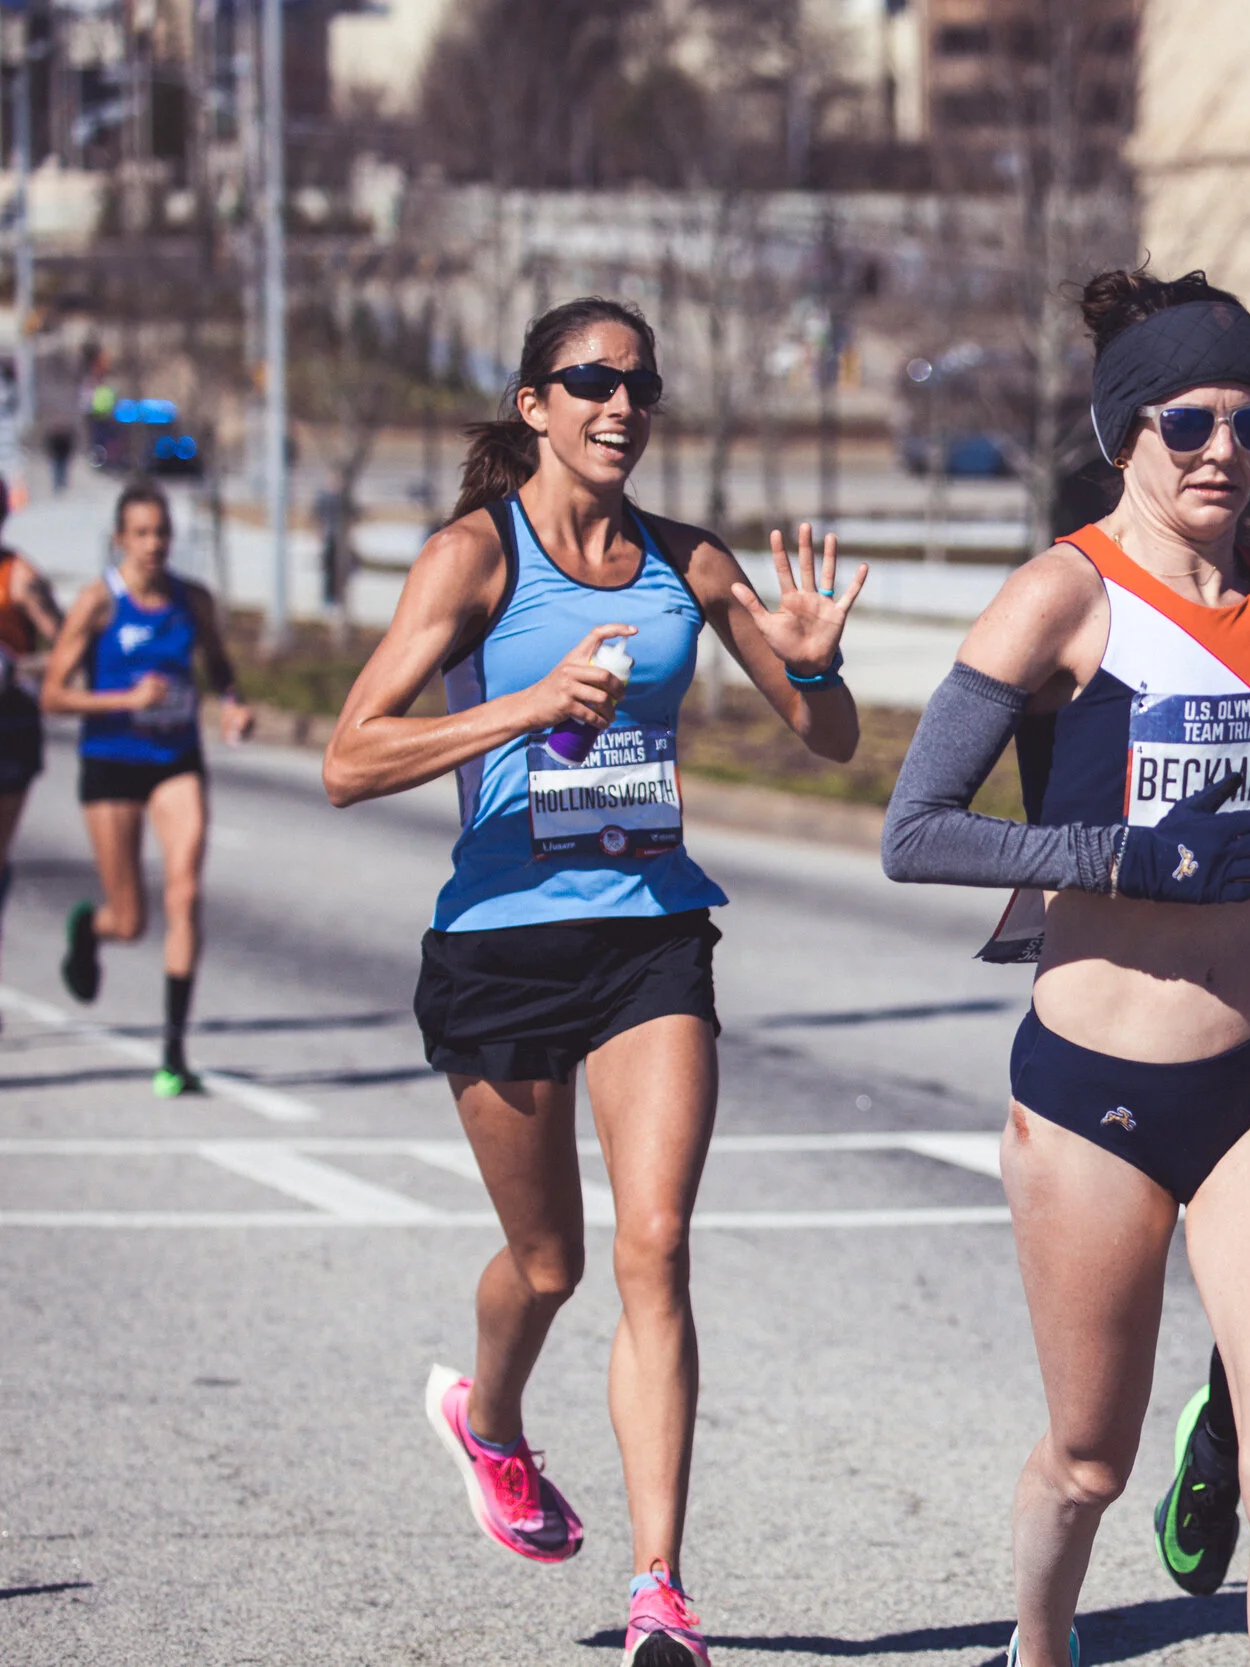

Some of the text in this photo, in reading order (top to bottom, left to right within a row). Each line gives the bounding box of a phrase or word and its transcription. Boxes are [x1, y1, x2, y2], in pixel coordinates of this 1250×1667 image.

[1184, 701, 1214, 720] U.S.
[1183, 722, 1224, 742] TEAM
[603, 747, 645, 766] TRIALS
[534, 779, 675, 813] HOLLINGSWORTH
